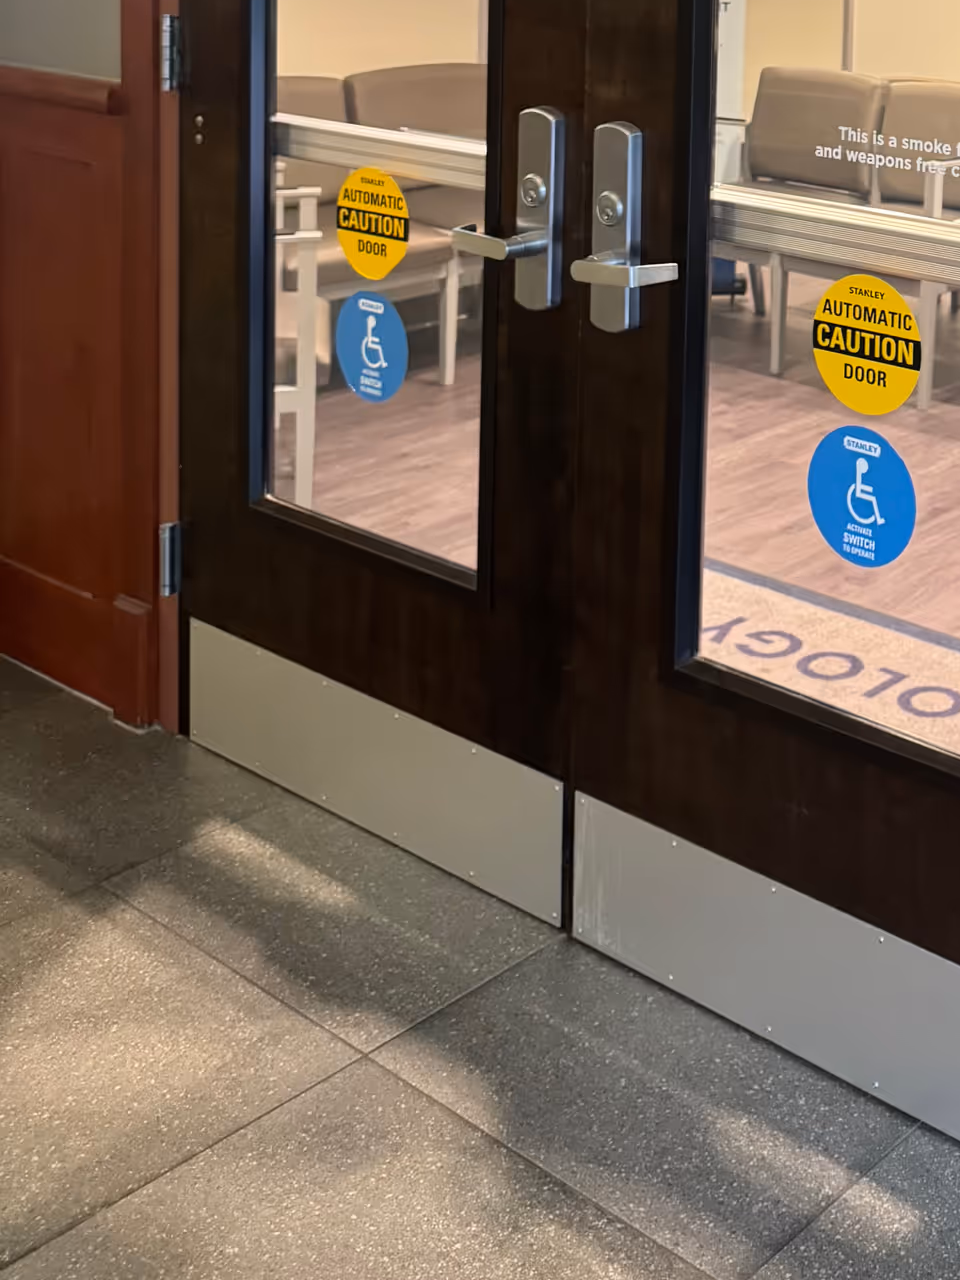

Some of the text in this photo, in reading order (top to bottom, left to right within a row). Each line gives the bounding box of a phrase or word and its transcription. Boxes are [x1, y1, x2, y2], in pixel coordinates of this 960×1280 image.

[838, 125, 868, 144] This
[872, 130, 885, 146] is
[888, 136, 897, 148] a
[901, 136, 951, 156] smoke
[815, 144, 841, 160] and
[846, 147, 912, 169] weapons
[916, 157, 946, 176] free
[343, 187, 404, 211] AUTOMATIC
[338, 207, 405, 239] CAUTION
[357, 239, 387, 258] DOOR
[848, 286, 886, 300] STANLEY
[822, 298, 913, 331] AUTOMATIC
[816, 323, 914, 366] CAUTION
[843, 363, 887, 388] DOOR
[846, 438, 878, 455] STANLEY
[842, 531, 876, 551] SWITCH
